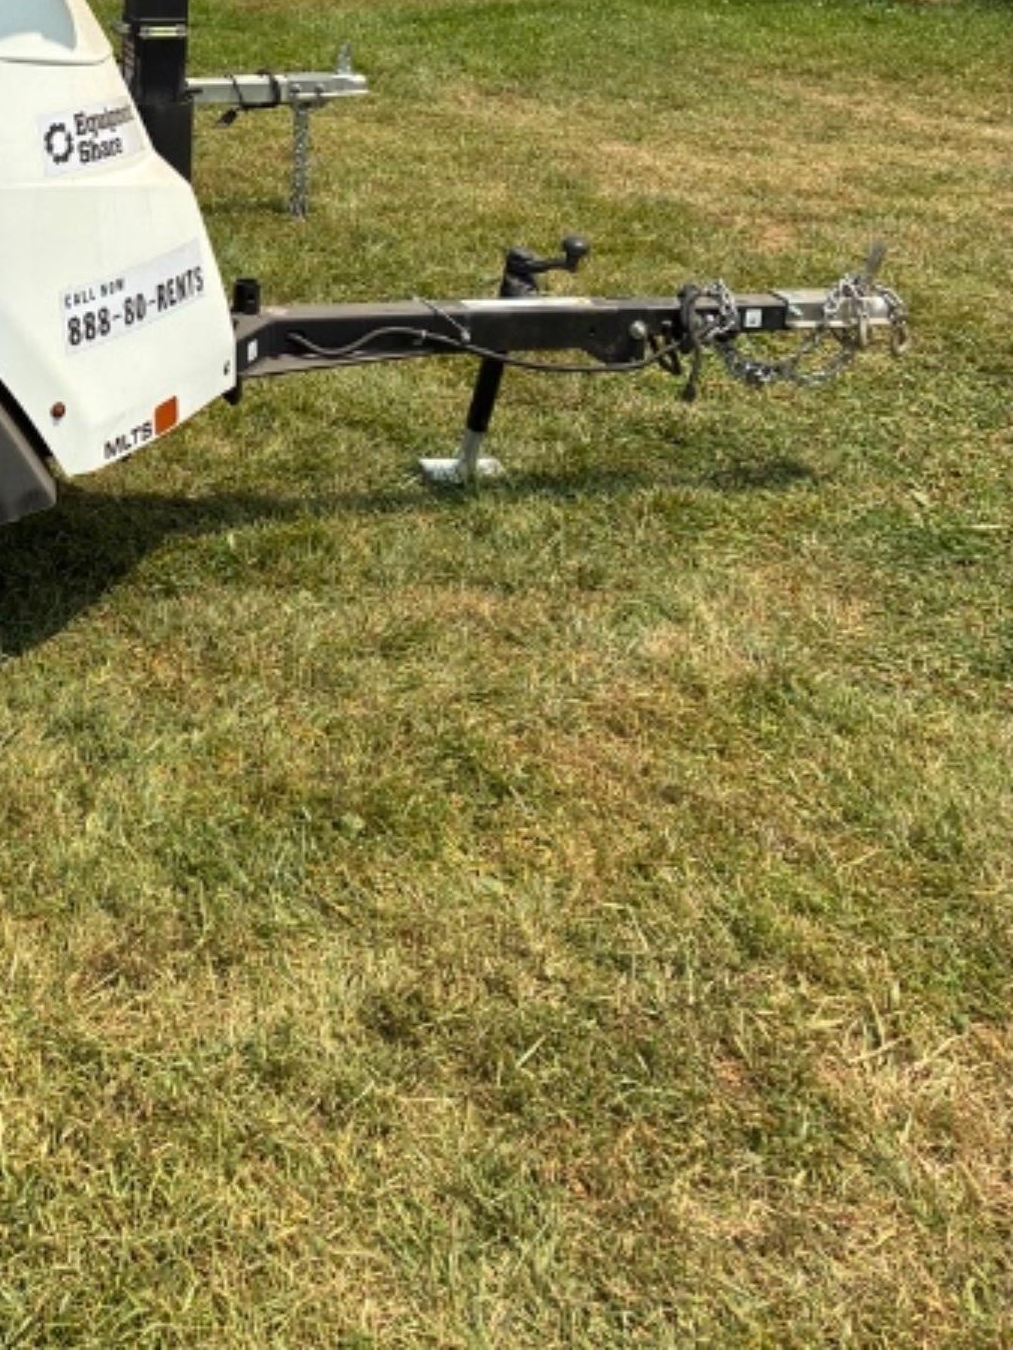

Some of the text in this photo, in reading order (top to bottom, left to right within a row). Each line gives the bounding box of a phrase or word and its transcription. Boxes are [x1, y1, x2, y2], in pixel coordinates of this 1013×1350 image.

[73, 106, 134, 138] Equip
[77, 137, 124, 165] Share
[65, 287, 96, 309] CALL
[68, 266, 204, 346] 888-80-RENTS
[104, 420, 152, 460] MLTS
